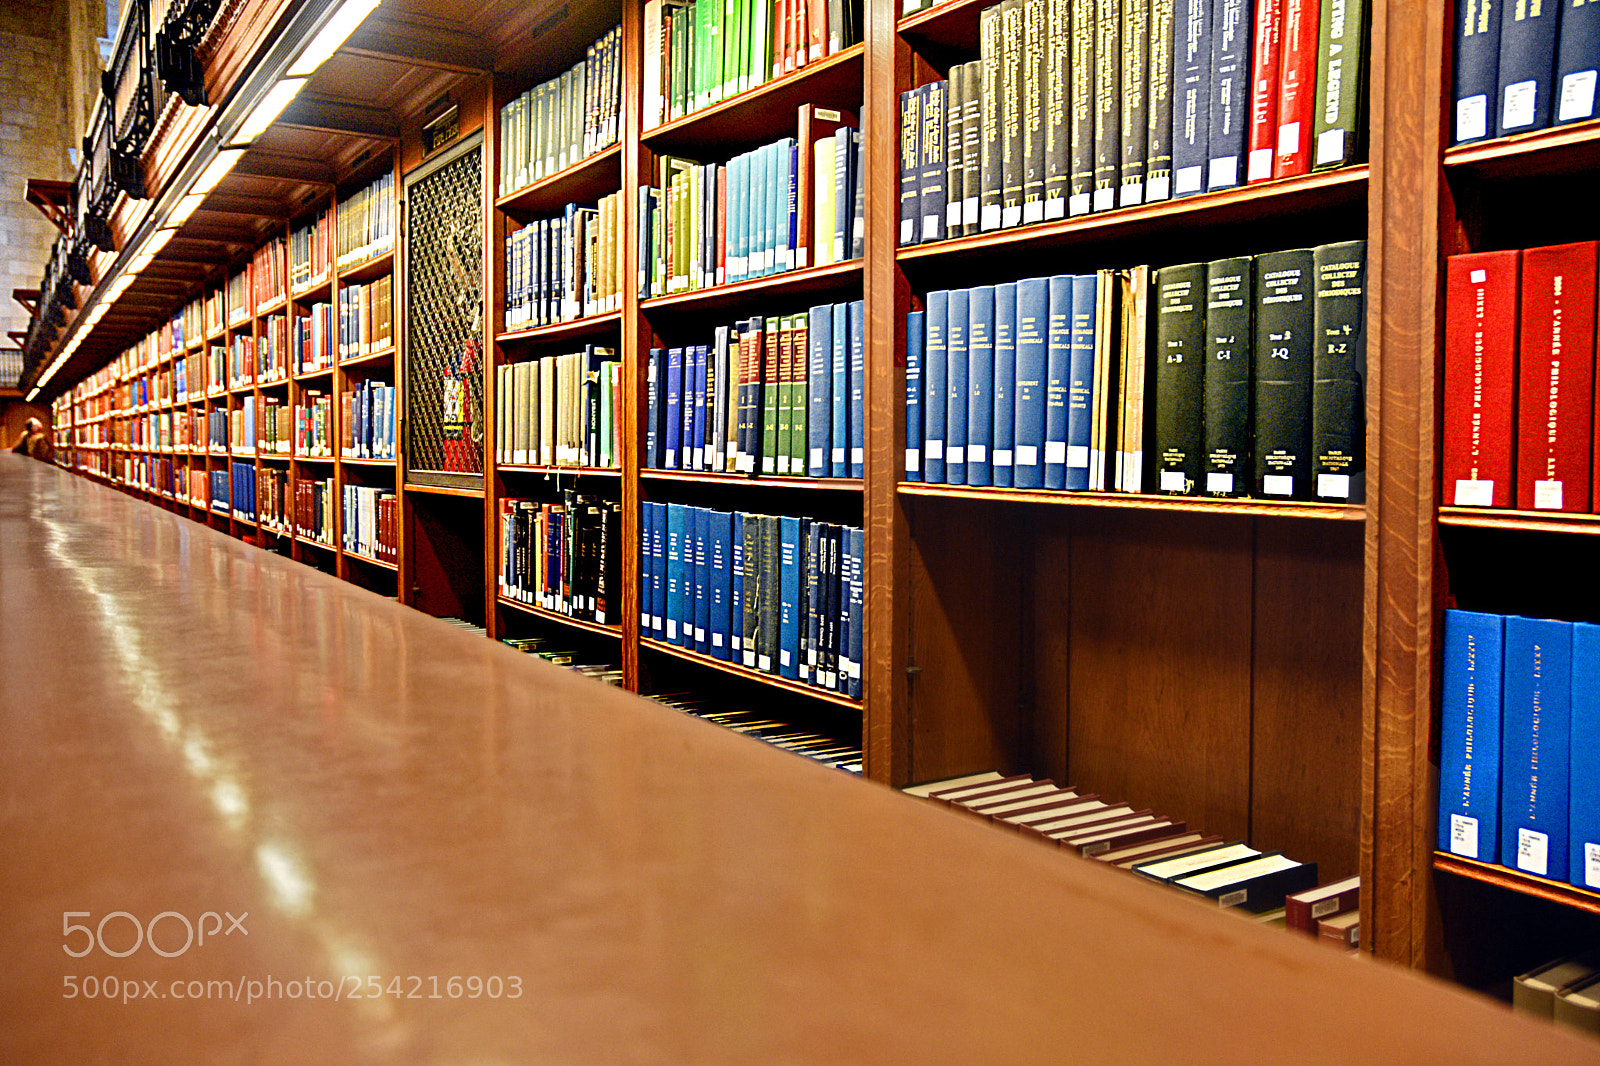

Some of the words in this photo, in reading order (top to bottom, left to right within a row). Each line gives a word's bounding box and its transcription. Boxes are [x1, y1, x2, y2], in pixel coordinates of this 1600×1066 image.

[1031, 0, 1039, 42] Catalogue
[1103, 31, 1113, 86] Manuscripts
[1131, 22, 1141, 81] Manuscripts
[1158, 15, 1169, 73] Manuscripts
[1329, 44, 1343, 57] A
[1054, 45, 1063, 100] Manuscripts
[1079, 41, 1088, 94] Manuscripts
[1097, 58, 1105, 94] Harvard
[1125, 51, 1133, 89] Harvard
[1152, 43, 1160, 81] Harvard
[1010, 60, 1018, 113] Manuscripts
[1031, 53, 1040, 107] Manuscripts
[1159, 84, 1168, 100] the
[1325, 59, 1342, 124] LEGEND
[1080, 105, 1088, 120] the
[1104, 97, 1113, 112] the
[1123, 90, 1132, 137] University
[1132, 92, 1141, 108] the
[1149, 81, 1158, 129] University
[1032, 117, 1040, 131] the
[1047, 108, 1055, 152] University
[1055, 110, 1063, 125] the
[1071, 102, 1080, 148] University
[1096, 94, 1104, 140] University
[1024, 115, 1032, 158] University
[1127, 146, 1133, 156] 7
[1153, 140, 1159, 150] 8
[1050, 164, 1056, 173] 4
[1074, 158, 1080, 166] 5
[1100, 153, 1106, 162] 6
[1007, 174, 1011, 183] 2
[1028, 170, 1034, 178] 3
[1210, 276, 1241, 285] CATALOGUE
[1264, 269, 1301, 280] CATALOGUE
[1320, 262, 1360, 272] CATALOGUE
[1321, 271, 1357, 280] COLLECTIF
[1266, 278, 1299, 288] COLLECTIF
[1331, 280, 1345, 288] DES
[1476, 289, 1484, 318] LXXIII
[1284, 330, 1291, 340] 3
[1343, 324, 1352, 335] 4
[1552, 309, 1562, 355] L'ANNÉE
[1167, 354, 1183, 364] A-B
[1216, 350, 1231, 360] C-I
[1271, 347, 1289, 360] J-Q
[1328, 343, 1347, 354] R-Z
[1474, 332, 1484, 408] PHILOLOGIQUE
[1548, 361, 1560, 443] PHILOLOGIQUE
[1471, 413, 1481, 455] L'ANNÉE
[1465, 683, 1475, 759] PHILOLOGIQUE
[1531, 691, 1541, 770] PHILOLOGIQUE
[1462, 764, 1472, 807] L'ANNÉE
[1529, 775, 1538, 820] L'ANNÉE
